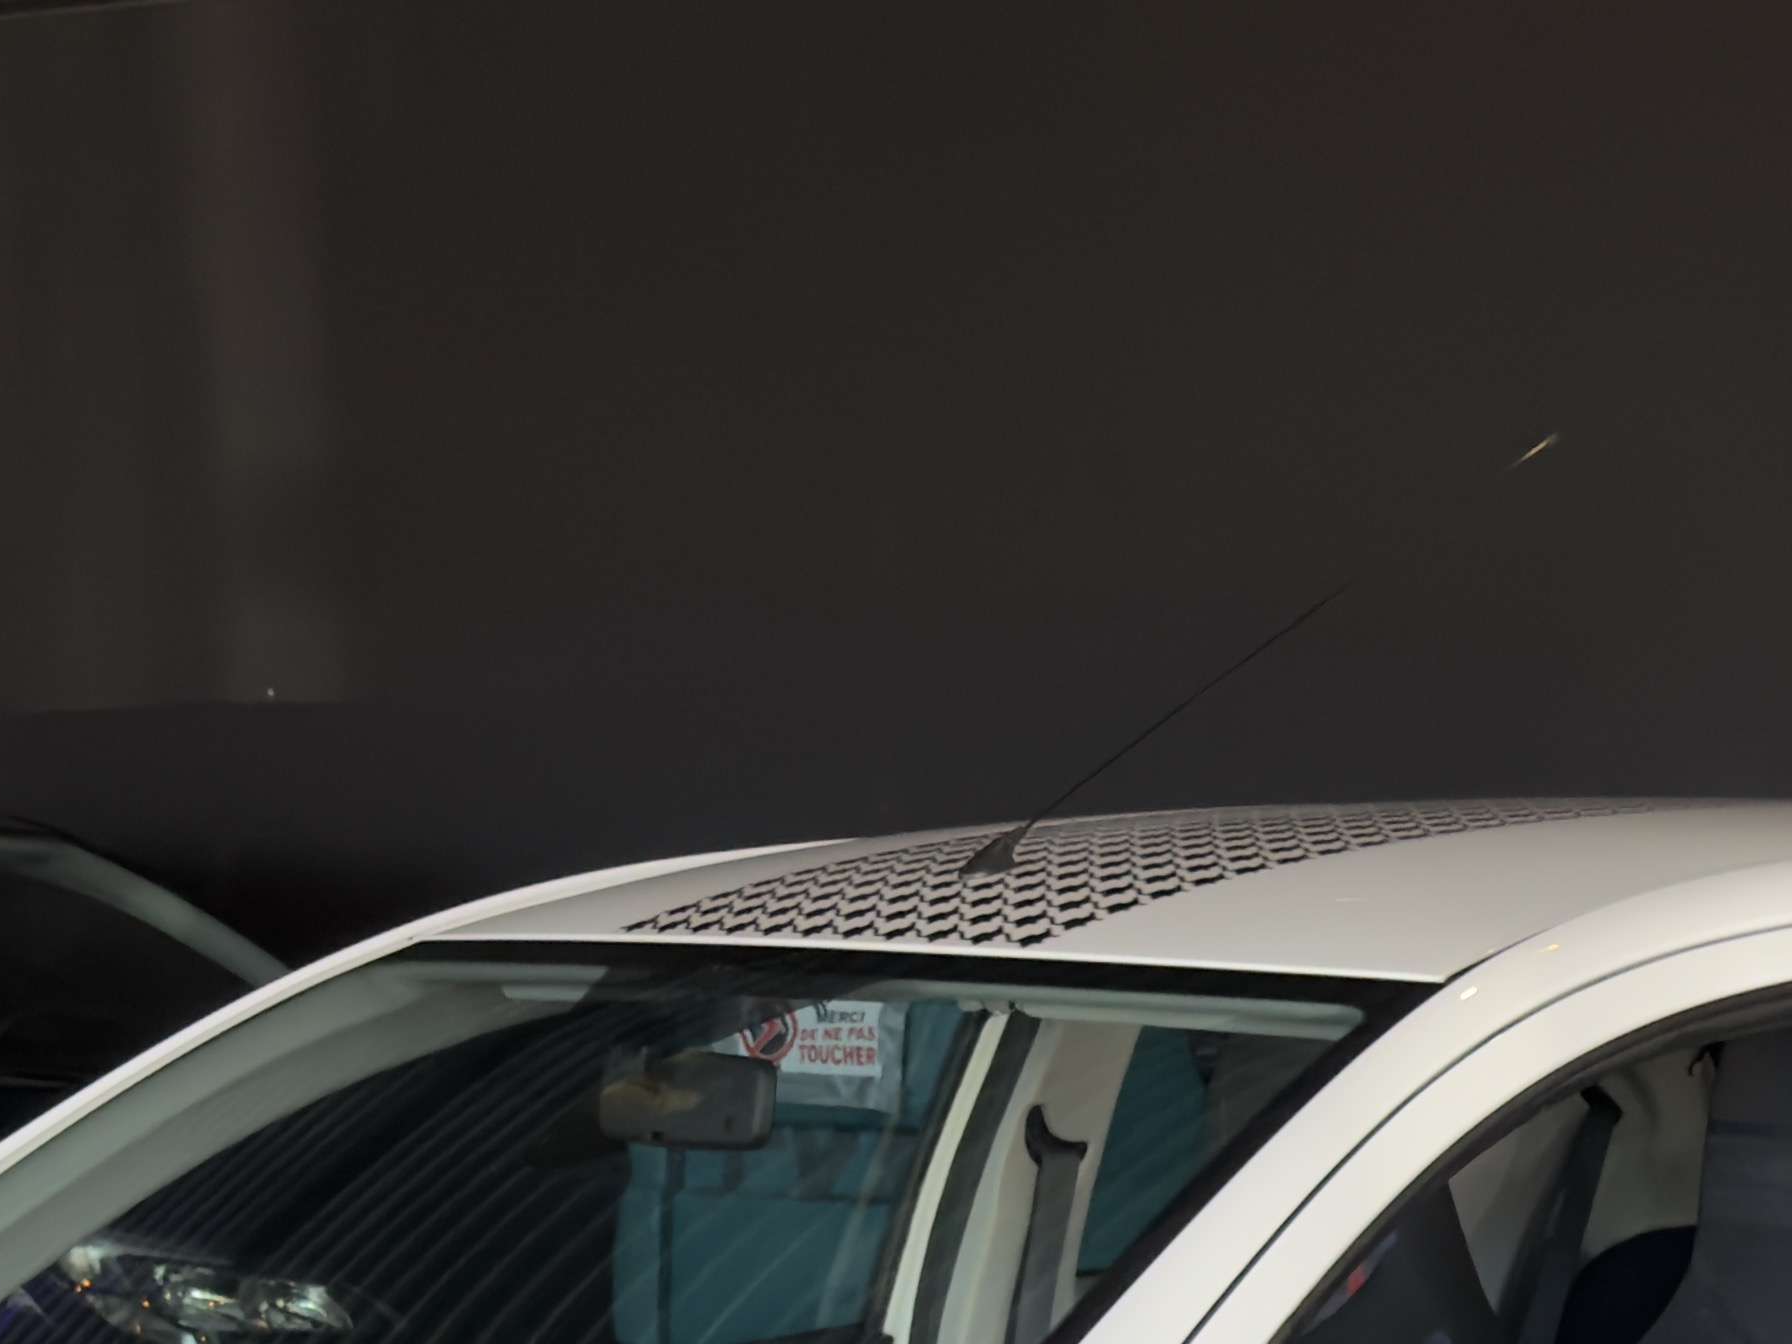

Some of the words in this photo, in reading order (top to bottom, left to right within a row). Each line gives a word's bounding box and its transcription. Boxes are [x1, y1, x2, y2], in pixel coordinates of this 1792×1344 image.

[822, 1027, 844, 1041] NE
[847, 1026, 876, 1041] PAS
[799, 1045, 876, 1066] TOUCHER
